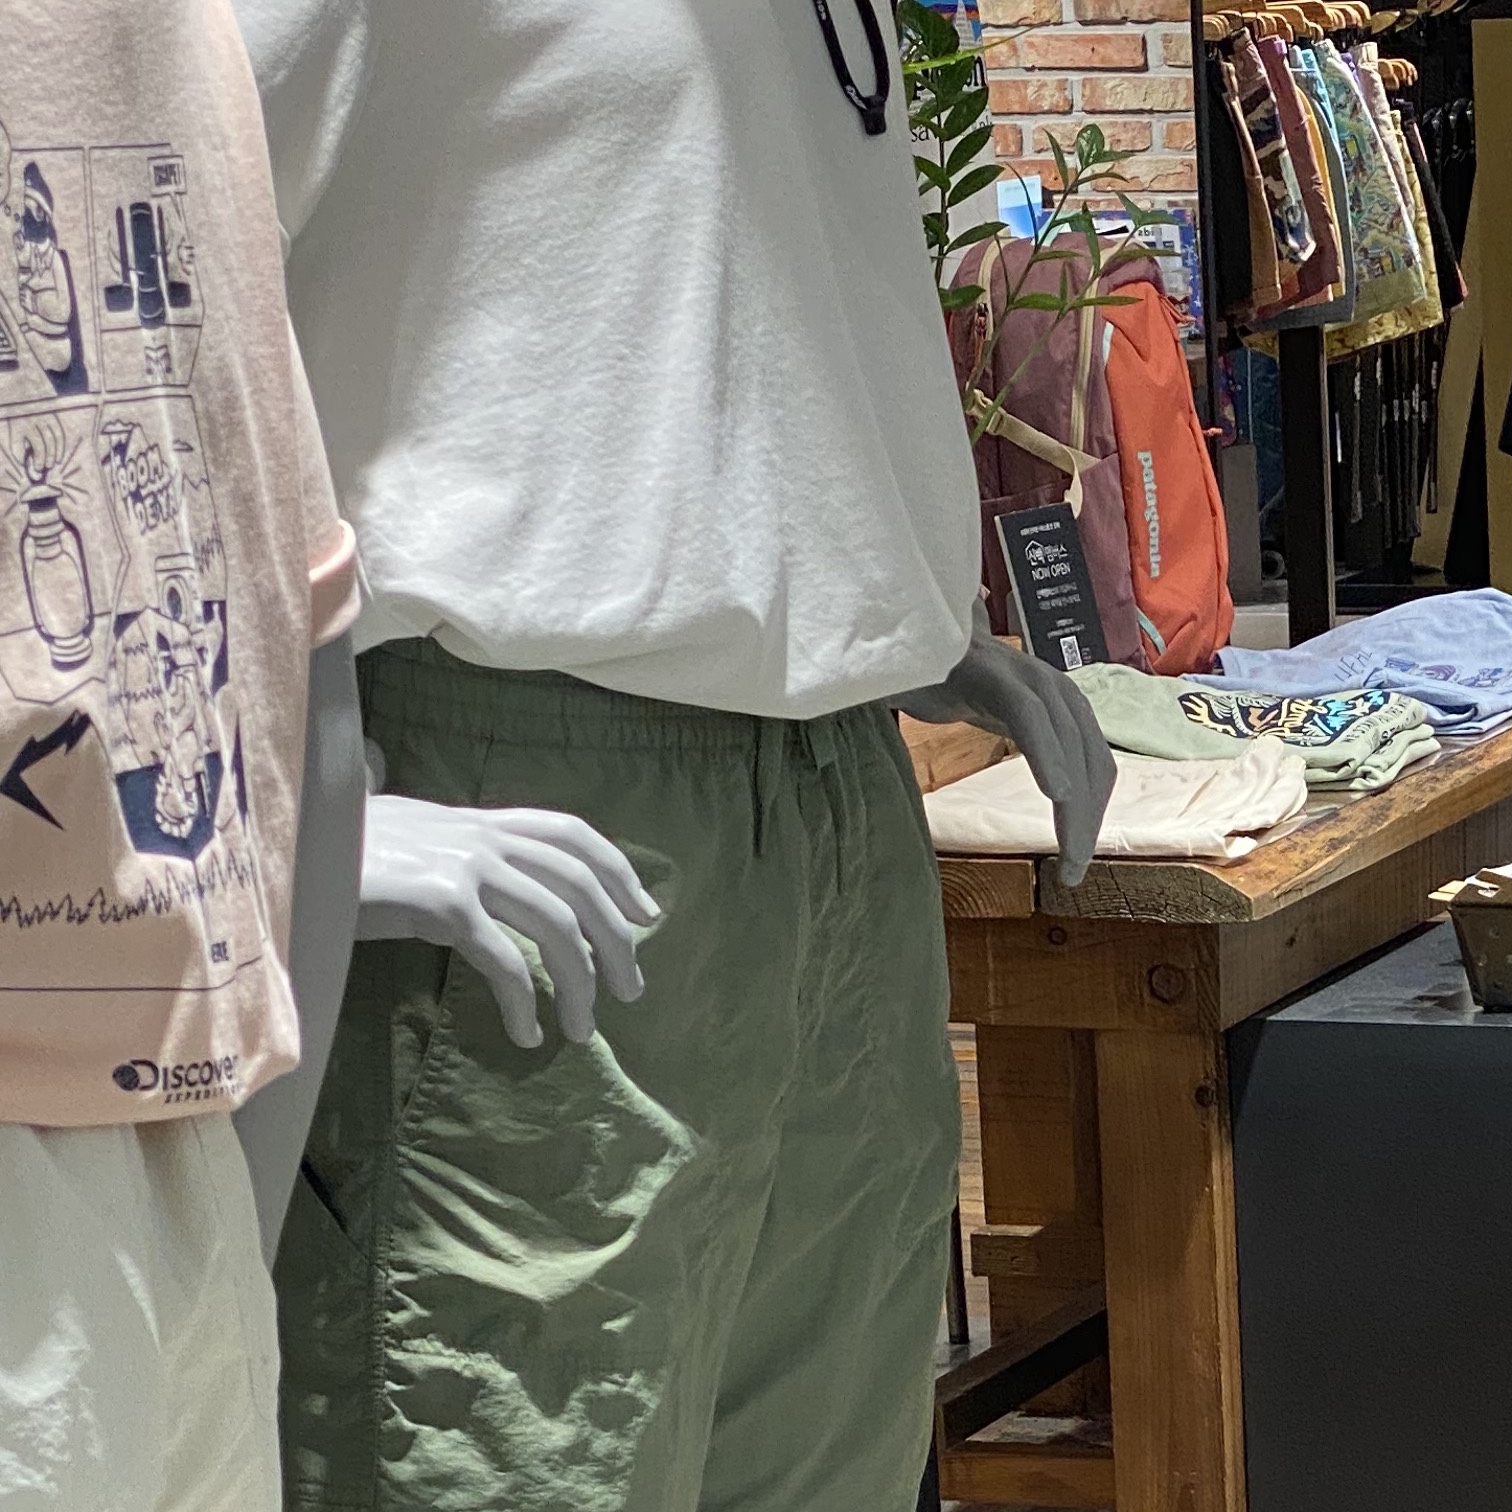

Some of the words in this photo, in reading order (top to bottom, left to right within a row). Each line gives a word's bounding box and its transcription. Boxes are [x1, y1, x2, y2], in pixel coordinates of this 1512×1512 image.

[1137, 451, 1161, 578] patagonia
[1031, 567, 1050, 581] NOW
[1051, 562, 1071, 577] OPEN
